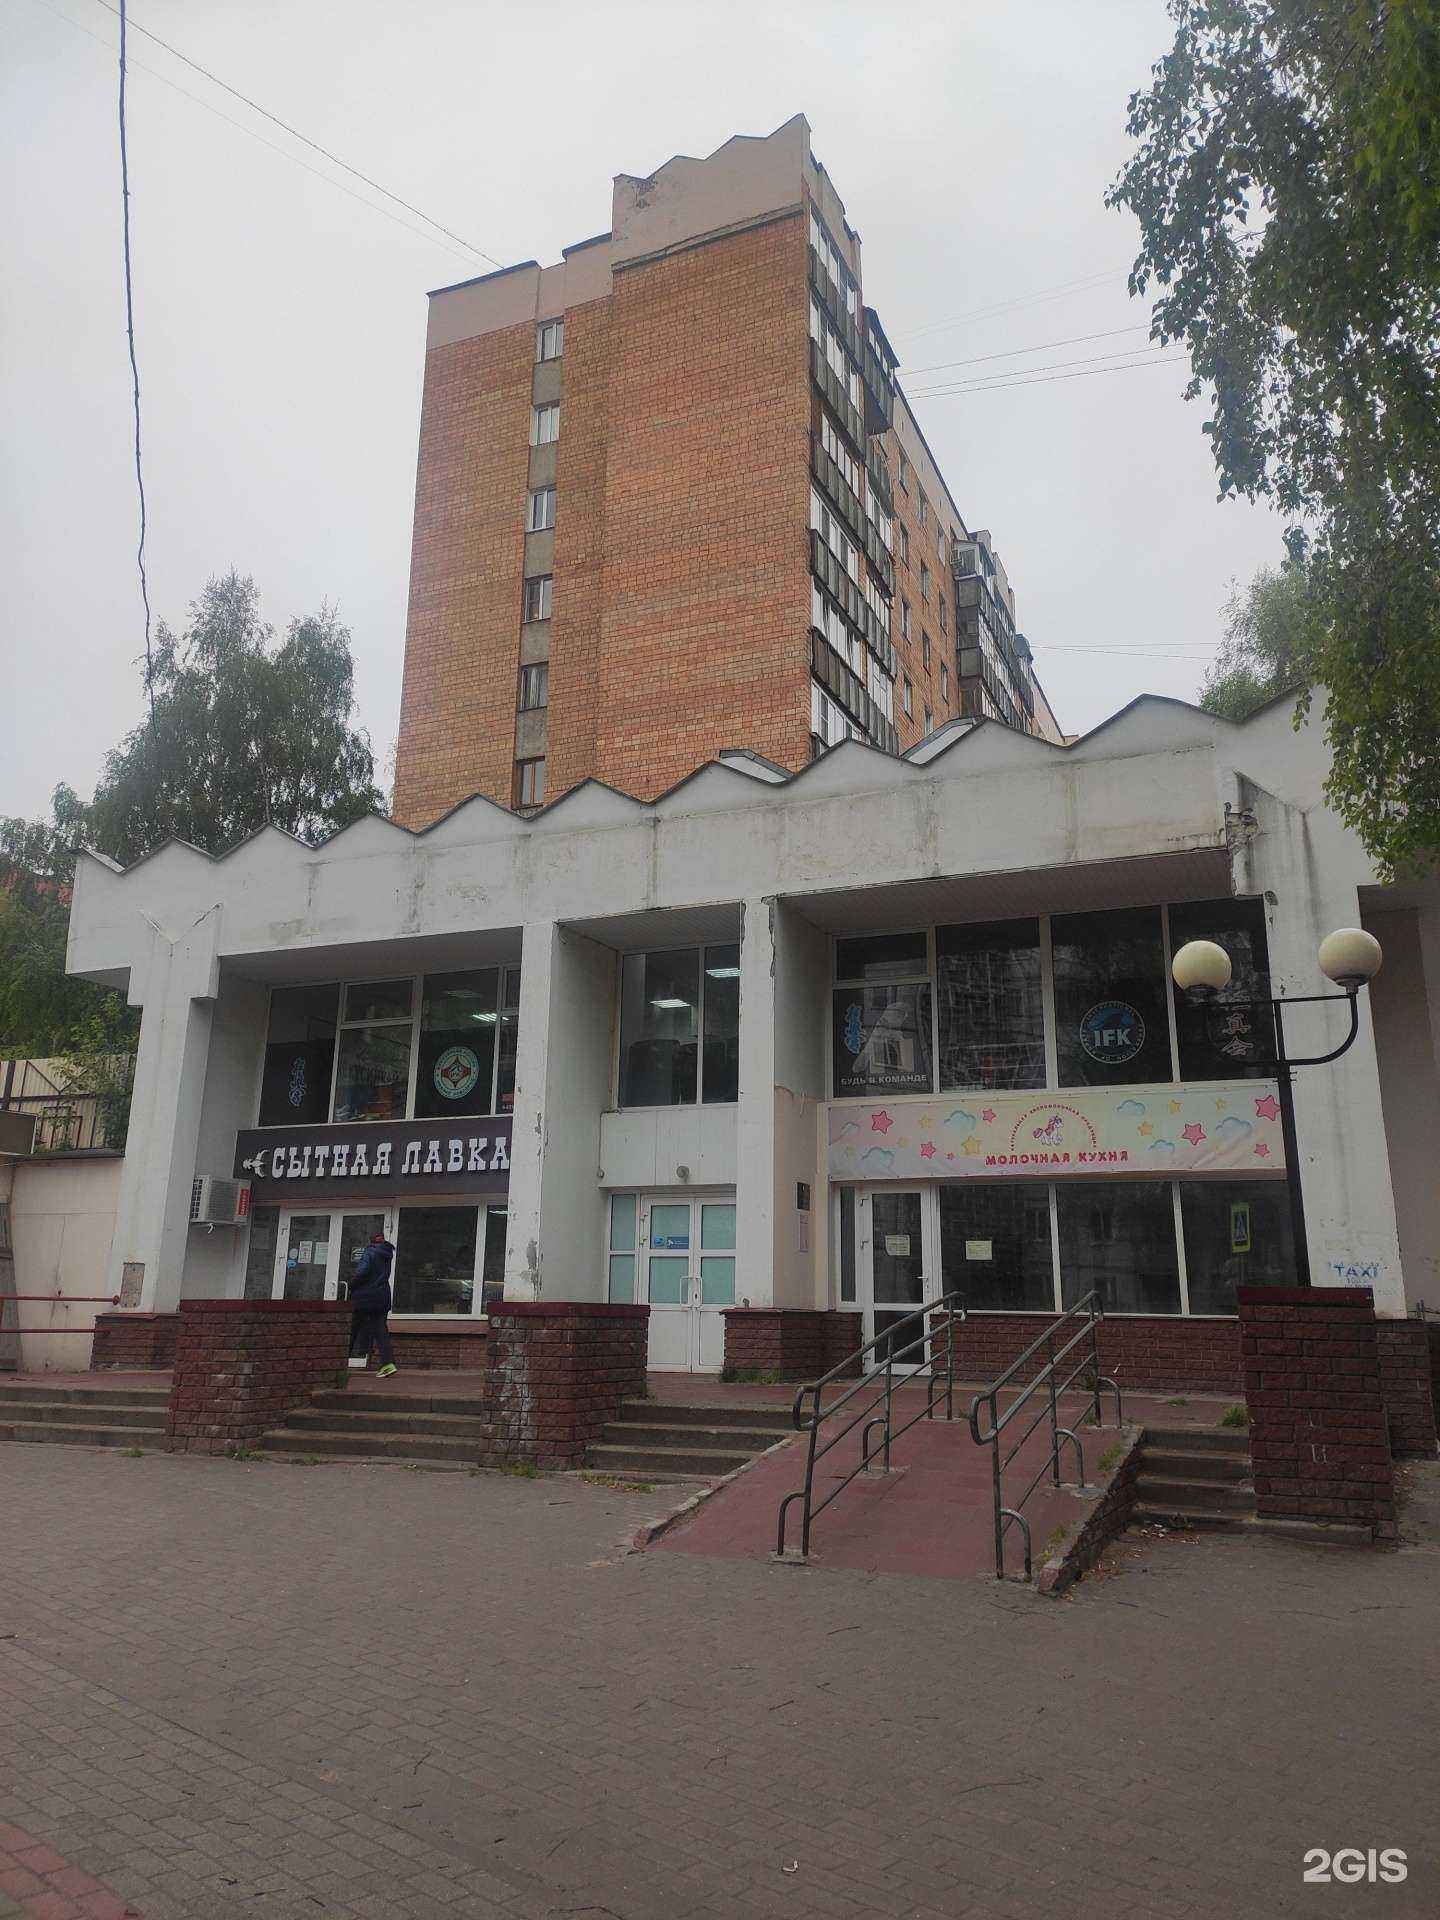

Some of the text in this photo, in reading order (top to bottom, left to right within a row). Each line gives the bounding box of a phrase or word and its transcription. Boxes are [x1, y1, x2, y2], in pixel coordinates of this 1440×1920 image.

[1094, 1028, 1132, 1047] IFK
[840, 1076, 866, 1086] БУДЬ
[879, 1073, 928, 1085] КОМАНДЕ
[272, 1136, 510, 1179] СЫТНАЯ ЛАВКА
[985, 1150, 1129, 1166] МОЛОЧНАЯ КУХНЯ
